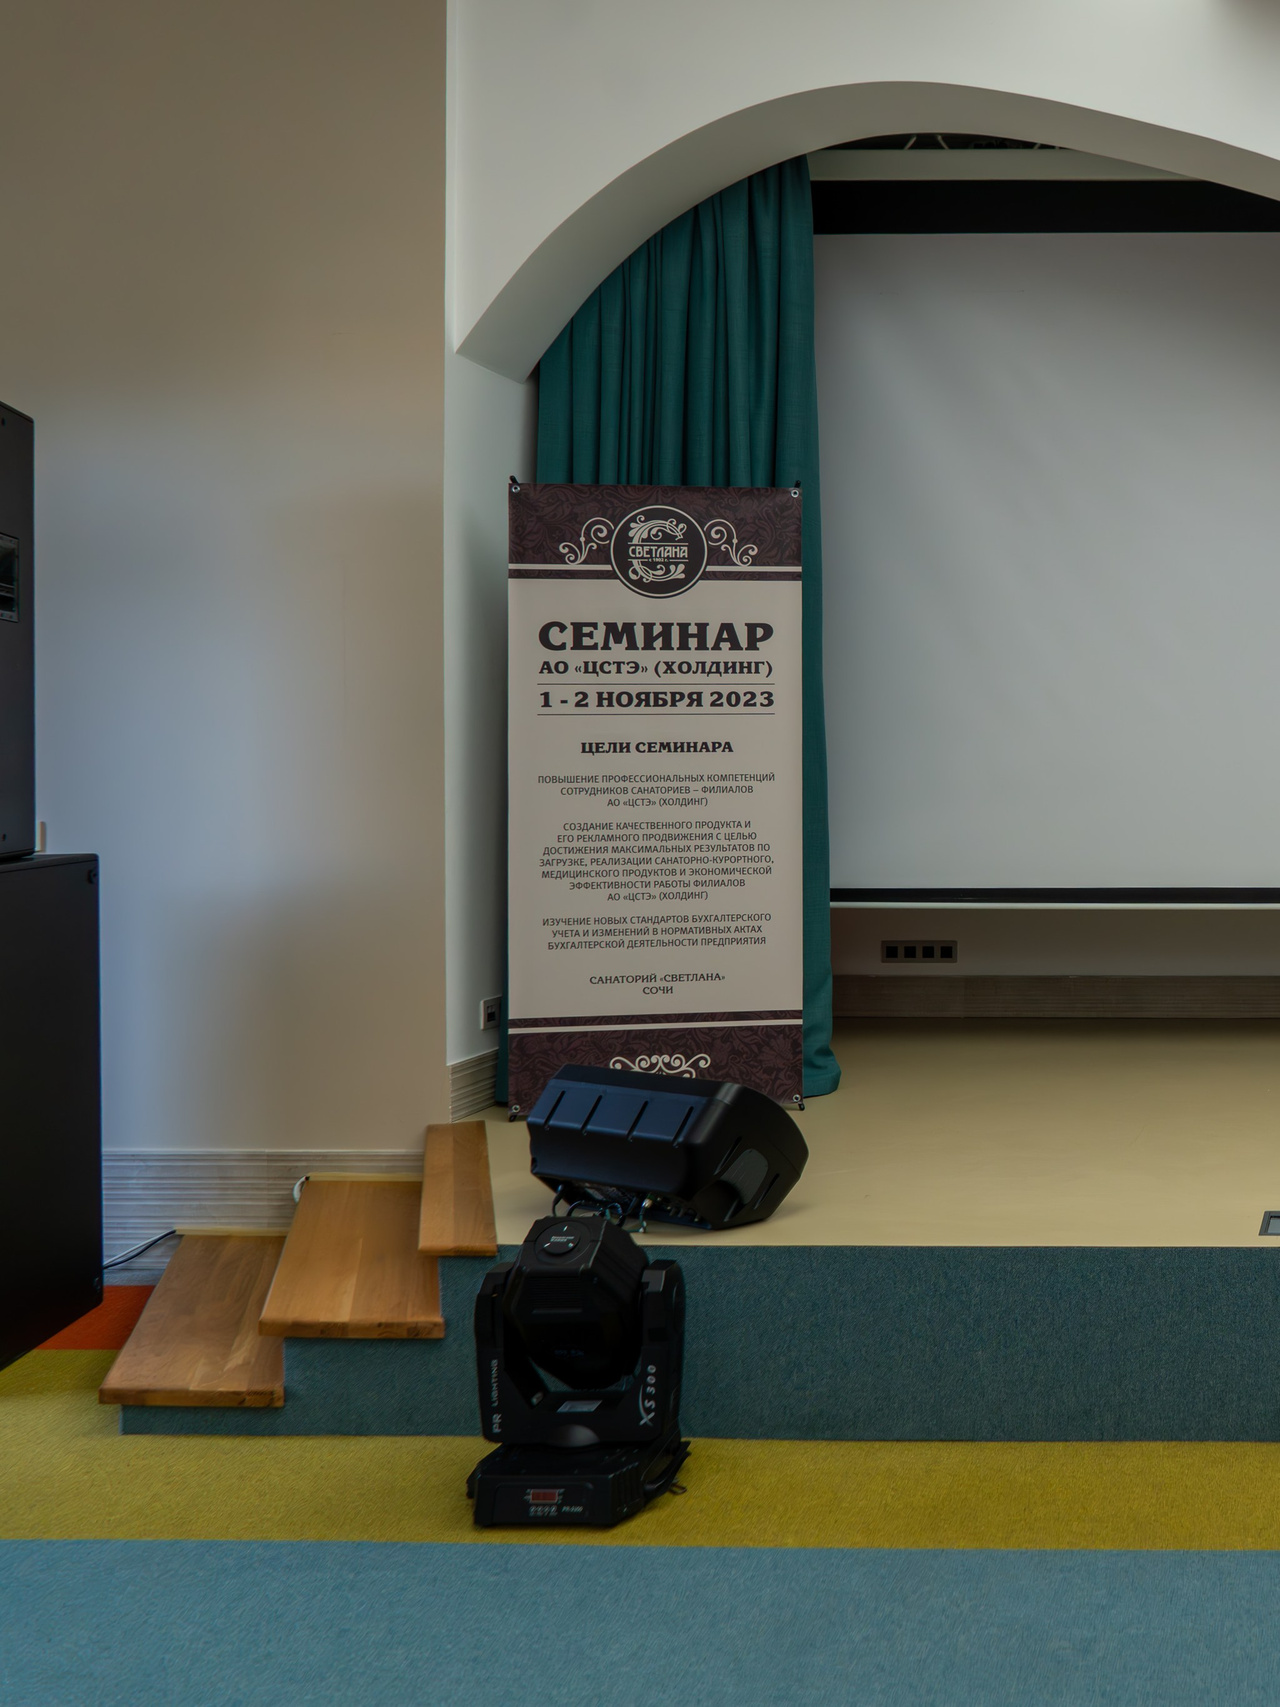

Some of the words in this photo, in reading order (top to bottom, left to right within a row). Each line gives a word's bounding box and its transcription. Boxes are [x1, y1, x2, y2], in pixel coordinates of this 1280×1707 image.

[628, 546, 688, 558] СВЕТЛАНА
[538, 620, 774, 651] СЕМИНАР
[538, 660, 569, 674] АО
[574, 660, 648, 677] «ЦСТЭ»
[653, 660, 773, 678] (ХОЛДИНГ)
[539, 691, 552, 708] 1
[573, 690, 589, 708] 2
[595, 690, 704, 708] НОЯБРЯ
[709, 690, 774, 708] 2023
[580, 741, 631, 756] ЦЕЛИ
[634, 740, 734, 754] СЕМИНАРА
[537, 774, 600, 784] ПОВЫШЕНИЕ
[601, 773, 705, 783] ПРОФЕССИОНАЛЬНЫХ
[706, 771, 775, 783] КОМПЕТЕНЦИЙ
[559, 786, 629, 797] СОТРУДНИКОВ
[630, 785, 691, 795] САНАТОРИЕВ
[700, 784, 754, 794] ФИЛИАЛОВ
[606, 798, 621, 807] АО
[622, 797, 657, 808] «ЦСТЭ»
[658, 796, 708, 808] (ХОЛДИНГ)
[562, 821, 614, 832] СОЗДАНИЕ
[615, 820, 693, 830] КАЧЕСТВЕННОГО
[694, 820, 743, 831] ПРОДУКТА
[743, 819, 751, 829] И
[556, 834, 575, 843] ЕГО
[576, 833, 640, 843] РЕКЛАМНОГО
[641, 832, 714, 843] ПРОДВИЖЕНИЯ
[715, 831, 722, 841] С
[723, 831, 757, 842] ЦЕЛЬЮ
[542, 845, 609, 857] ДОСТИЖЕНИЯ
[610, 844, 692, 854] МАКСИМАЛЬНЫХ
[693, 843, 755, 853] РЕЗУЛЬТАТОВ
[756, 842, 771, 852] ПО
[538, 857, 588, 867] ЗАГРУЗКЕ,
[589, 856, 652, 867] РЕАЛИЗАЦИИ
[653, 854, 774, 866] САНАТОРНО-КУРОРТНОГО,
[540, 868, 620, 880] МЕДИЦИНСКОГО
[621, 867, 678, 879] ПРОДУКТОВ
[679, 867, 686, 876] И
[688, 865, 772, 876] ЭКОНОМИЧЕСКОЙ
[568, 880, 651, 891] ЭФФЕКТИВНОСТИ
[653, 879, 691, 889] РАБОТЫ
[692, 878, 746, 888] ФИЛИАЛОВ
[606, 892, 621, 901] АО
[622, 891, 657, 903] «ЦСТЭ»
[658, 890, 708, 901] (ХОЛДИНГ)
[542, 916, 591, 927] ИЗУЧЕНИЕ
[593, 915, 628, 925] НОВЫХ
[629, 914, 690, 926] СТАНДАРТОВ
[691, 912, 772, 923] БУХГАЛТЕРСКОГО
[551, 928, 581, 938] УЧЕТА
[582, 928, 589, 937] И
[591, 925, 650, 937] ИЗМЕНЕНИЙ
[651, 927, 659, 936] В
[660, 925, 732, 936] НОРМАТИВНЫХ
[732, 924, 763, 934] АКТАХ
[547, 938, 625, 950] БУХГАЛТЕРСКОЙ
[625, 937, 698, 950] ДЕЯТЕЛЬНОСТИ
[700, 936, 766, 947] ПРЕДПРИЯТИЯ
[588, 972, 657, 985] САНАТОРИЙ
[659, 972, 725, 983] «СВЕТЛАНА»
[641, 985, 673, 995] СОЧИ
[647, 1364, 656, 1394] 300
[639, 1385, 656, 1426] XS
[492, 1414, 501, 1433] PR
